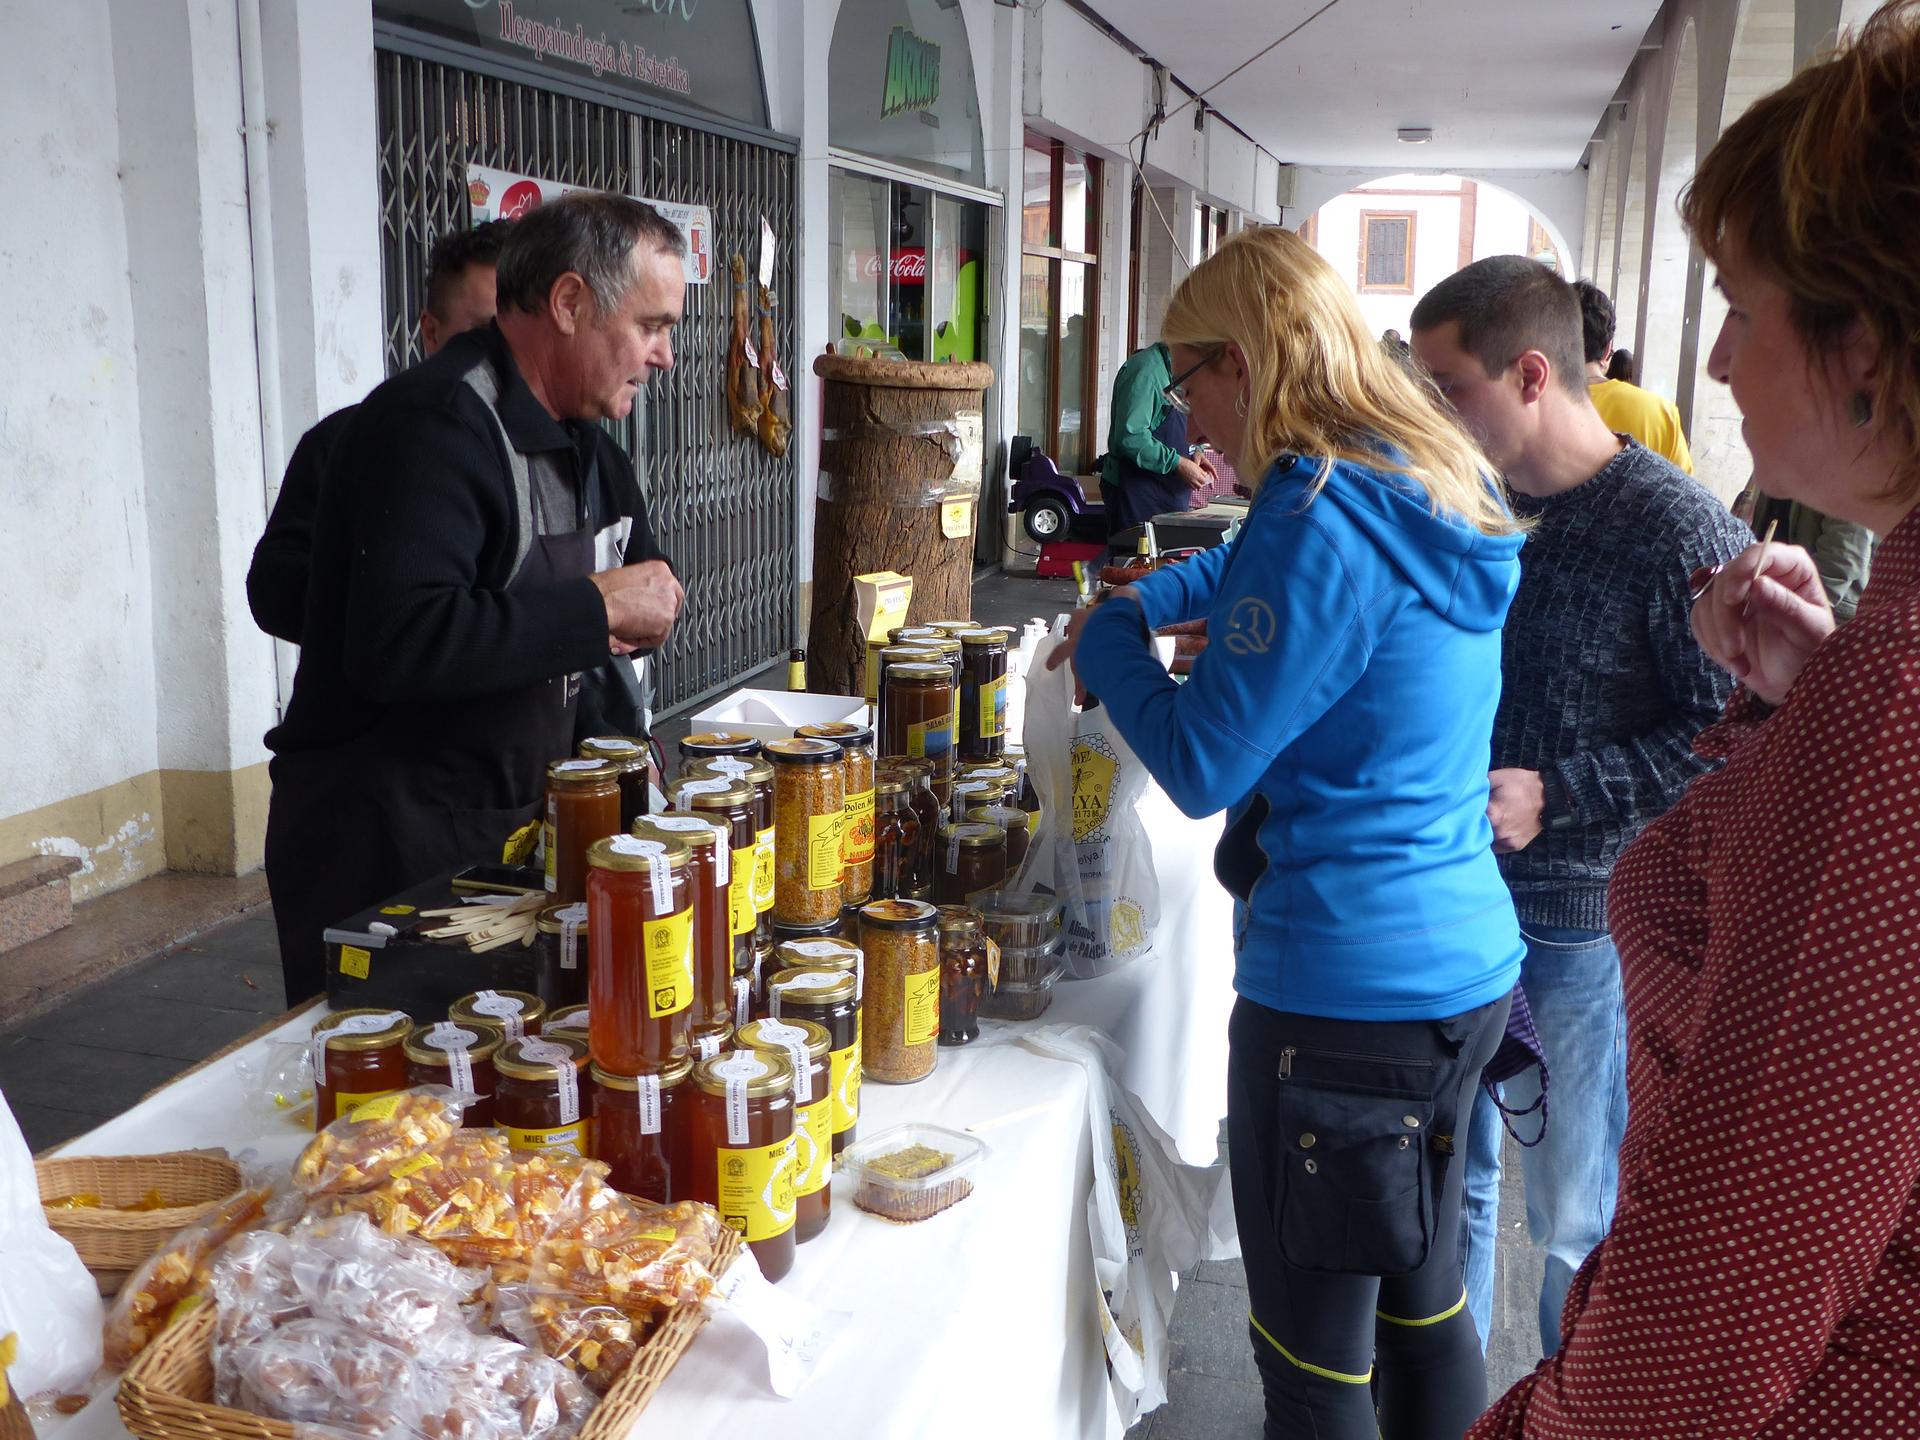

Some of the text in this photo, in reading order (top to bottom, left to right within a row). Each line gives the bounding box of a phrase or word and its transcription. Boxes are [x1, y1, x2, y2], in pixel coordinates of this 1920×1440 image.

[499, 1, 617, 77] Ileapaindegia
[619, 40, 633, 78] &
[633, 44, 691, 95] Estetika
[844, 801, 866, 813] Polen
[1071, 794, 1103, 810] LYA
[657, 871, 666, 905] Artesano
[645, 1093, 653, 1126] Artesano
[732, 1102, 740, 1136] Artesano
[523, 1134, 546, 1144] MIEL
[769, 1146, 786, 1160] MIEL
